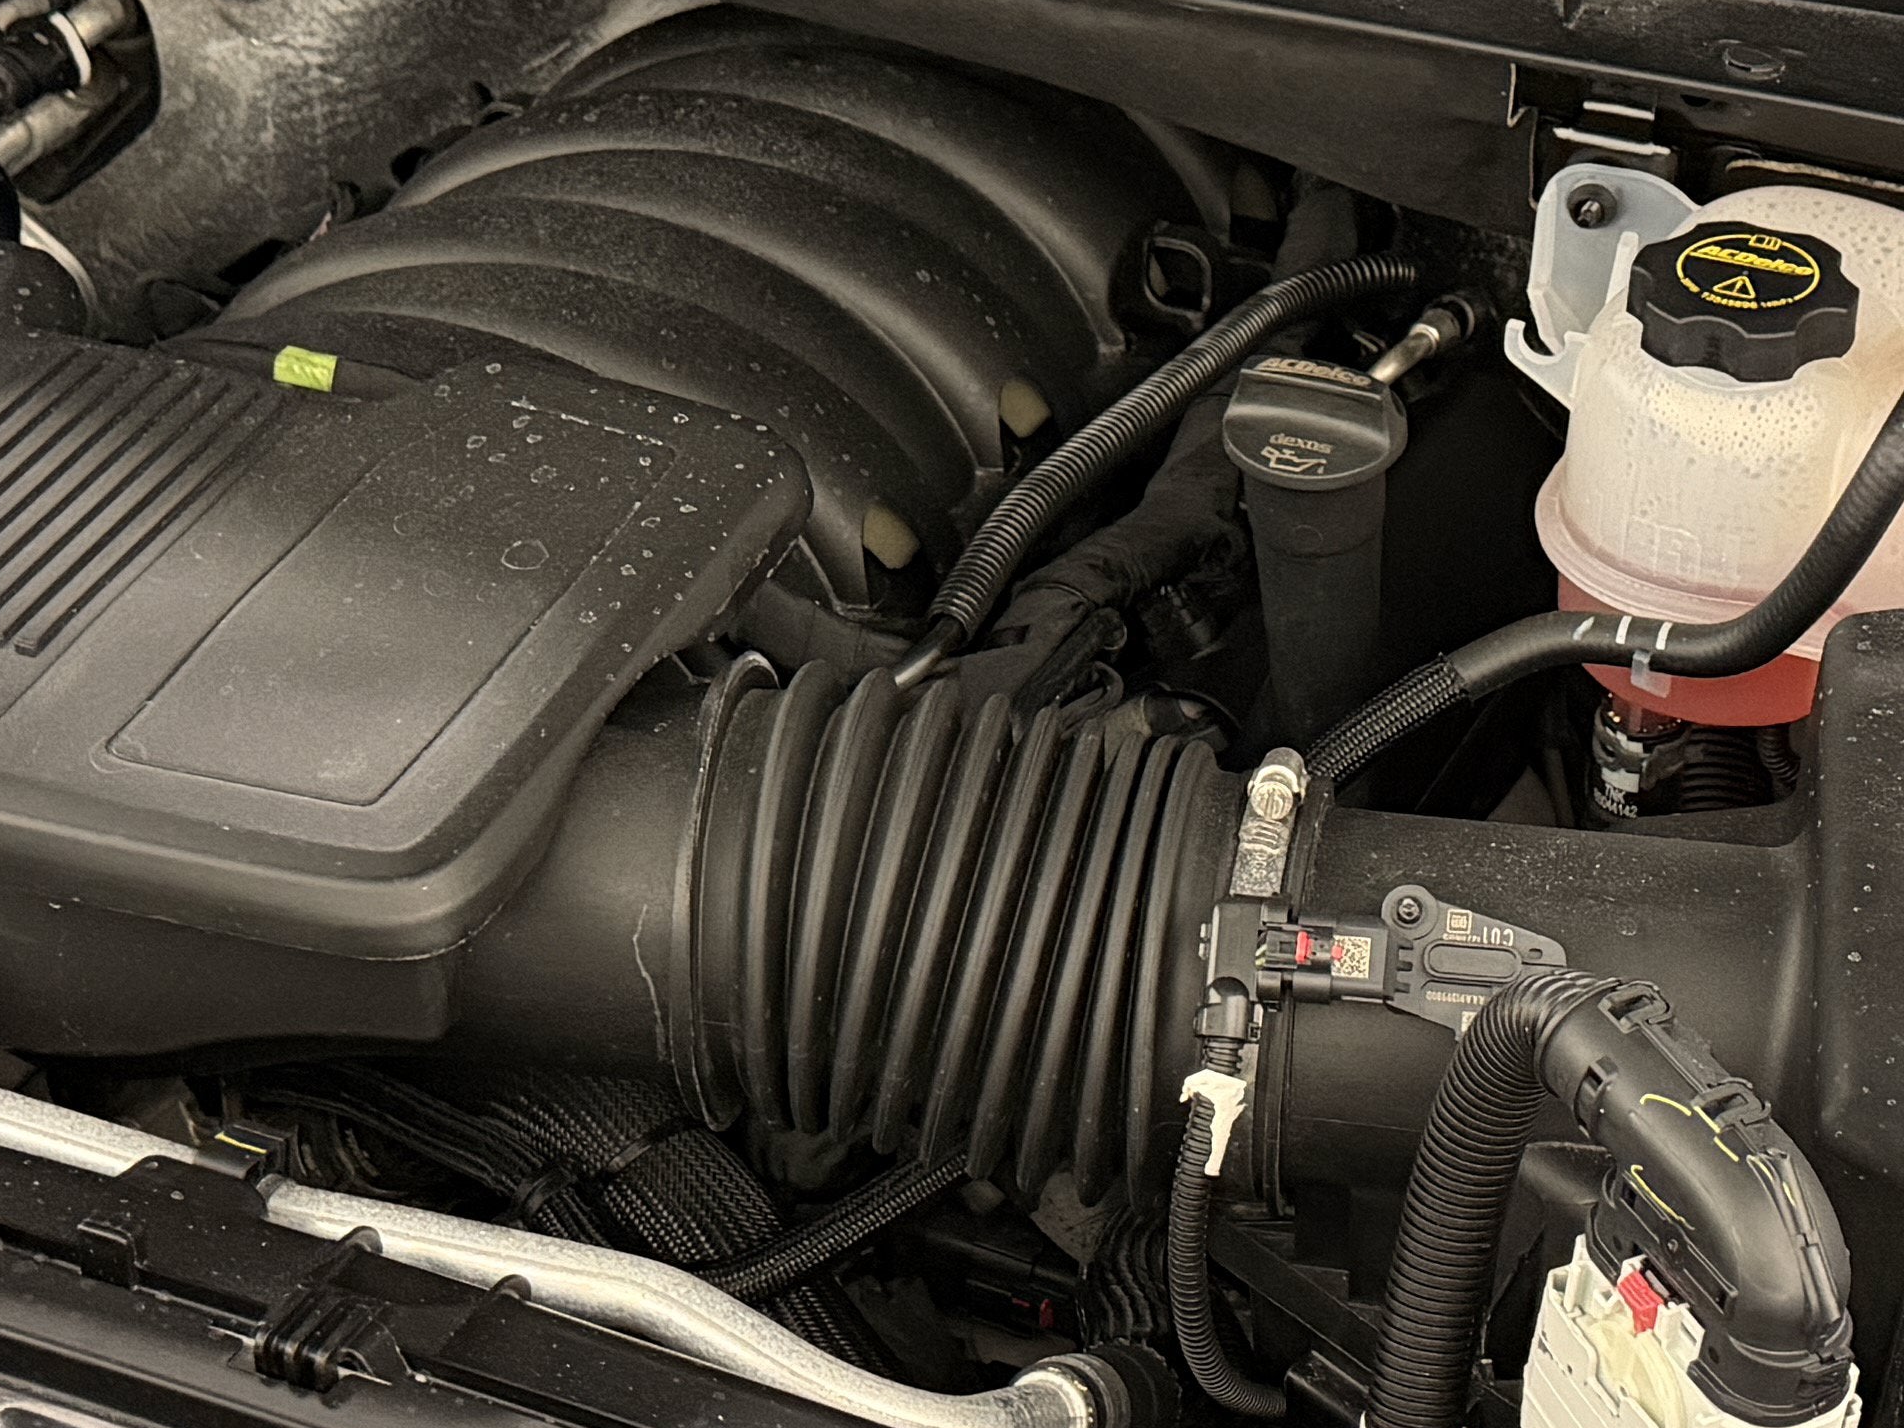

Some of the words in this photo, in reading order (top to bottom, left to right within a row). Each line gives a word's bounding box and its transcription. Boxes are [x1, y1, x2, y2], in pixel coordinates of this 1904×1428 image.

[1696, 245, 1814, 276] ACDelco
[1254, 357, 1372, 386] ACDelco
[1269, 433, 1333, 453] dexos
